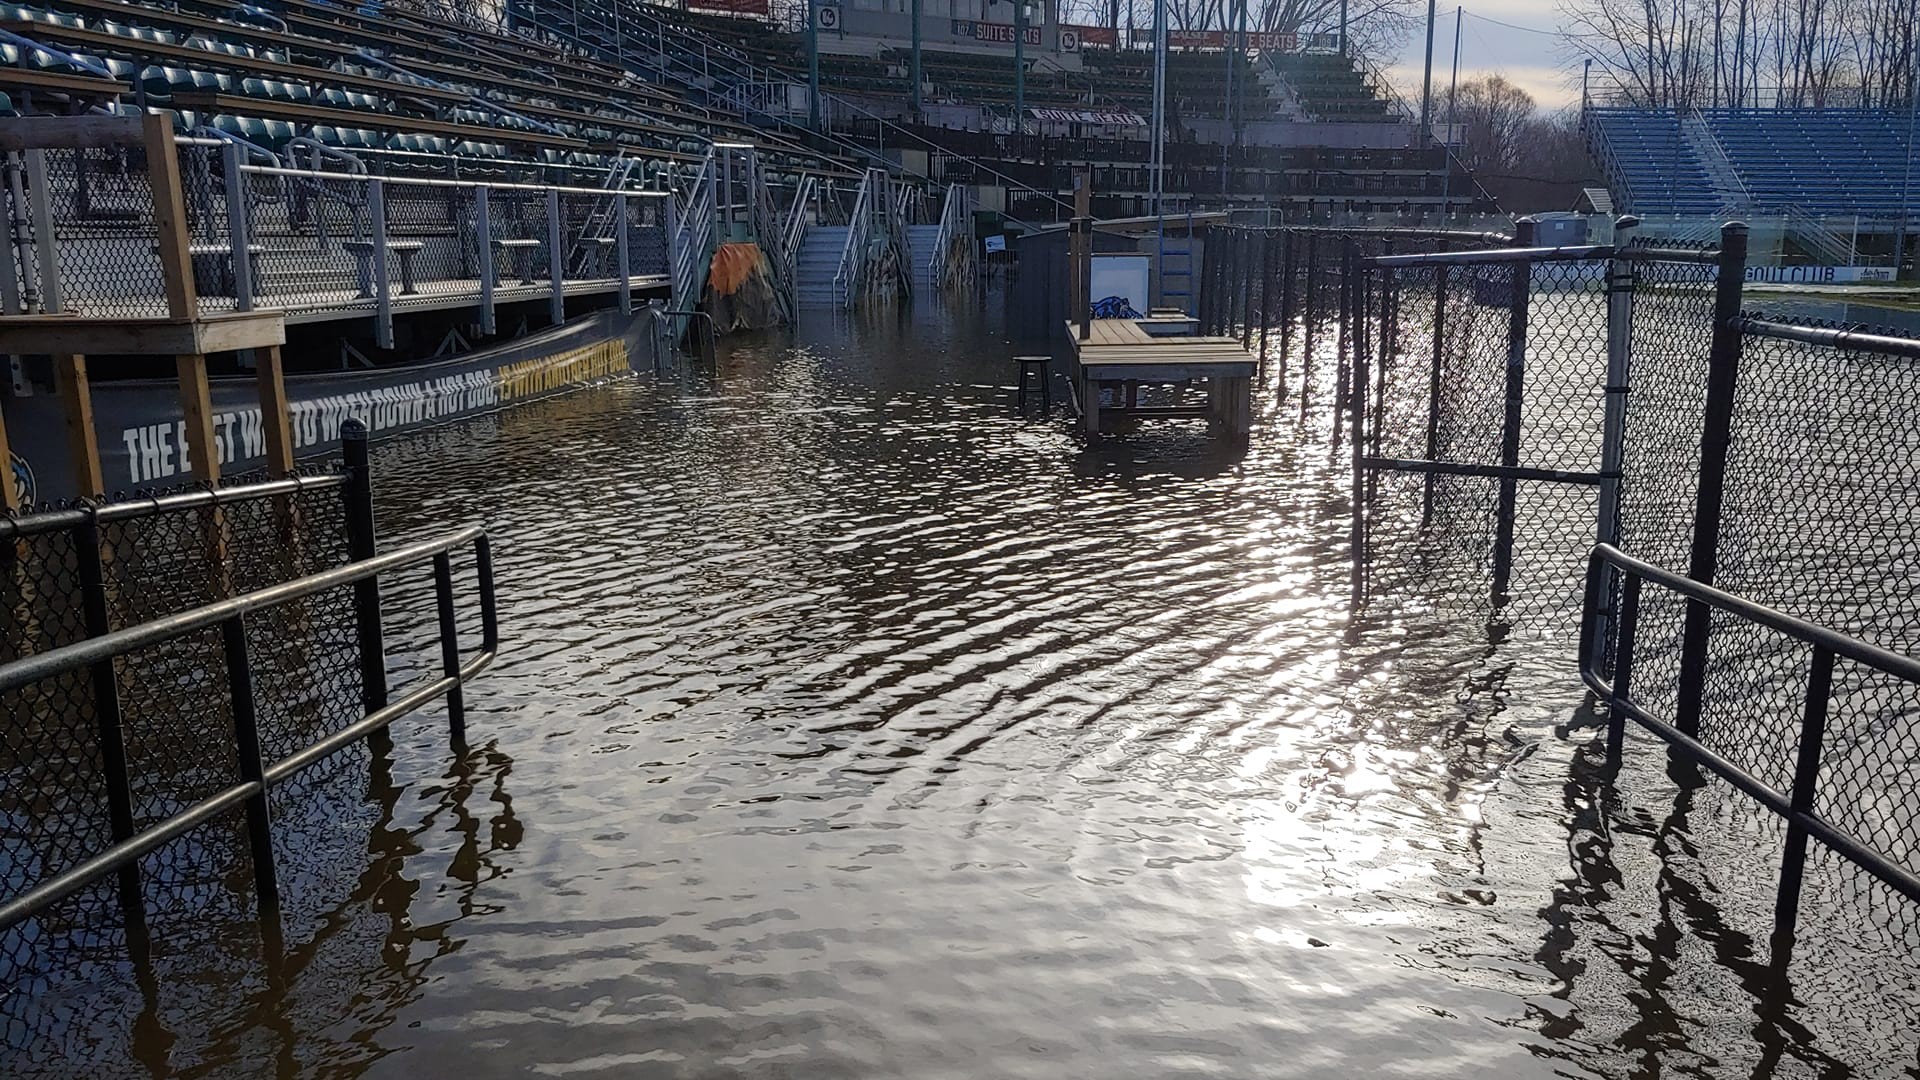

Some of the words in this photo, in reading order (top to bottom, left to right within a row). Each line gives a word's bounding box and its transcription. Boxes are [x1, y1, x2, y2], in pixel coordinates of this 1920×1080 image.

[957, 24, 969, 36] 107
[976, 23, 1006, 41] SUITE
[1008, 27, 1040, 44] SATS
[1259, 34, 1295, 49] SEATS
[123, 422, 175, 484] THE
[289, 400, 318, 449] TO
[371, 382, 427, 431] DOWN
[424, 379, 440, 419] A
[436, 374, 467, 417] HOT
